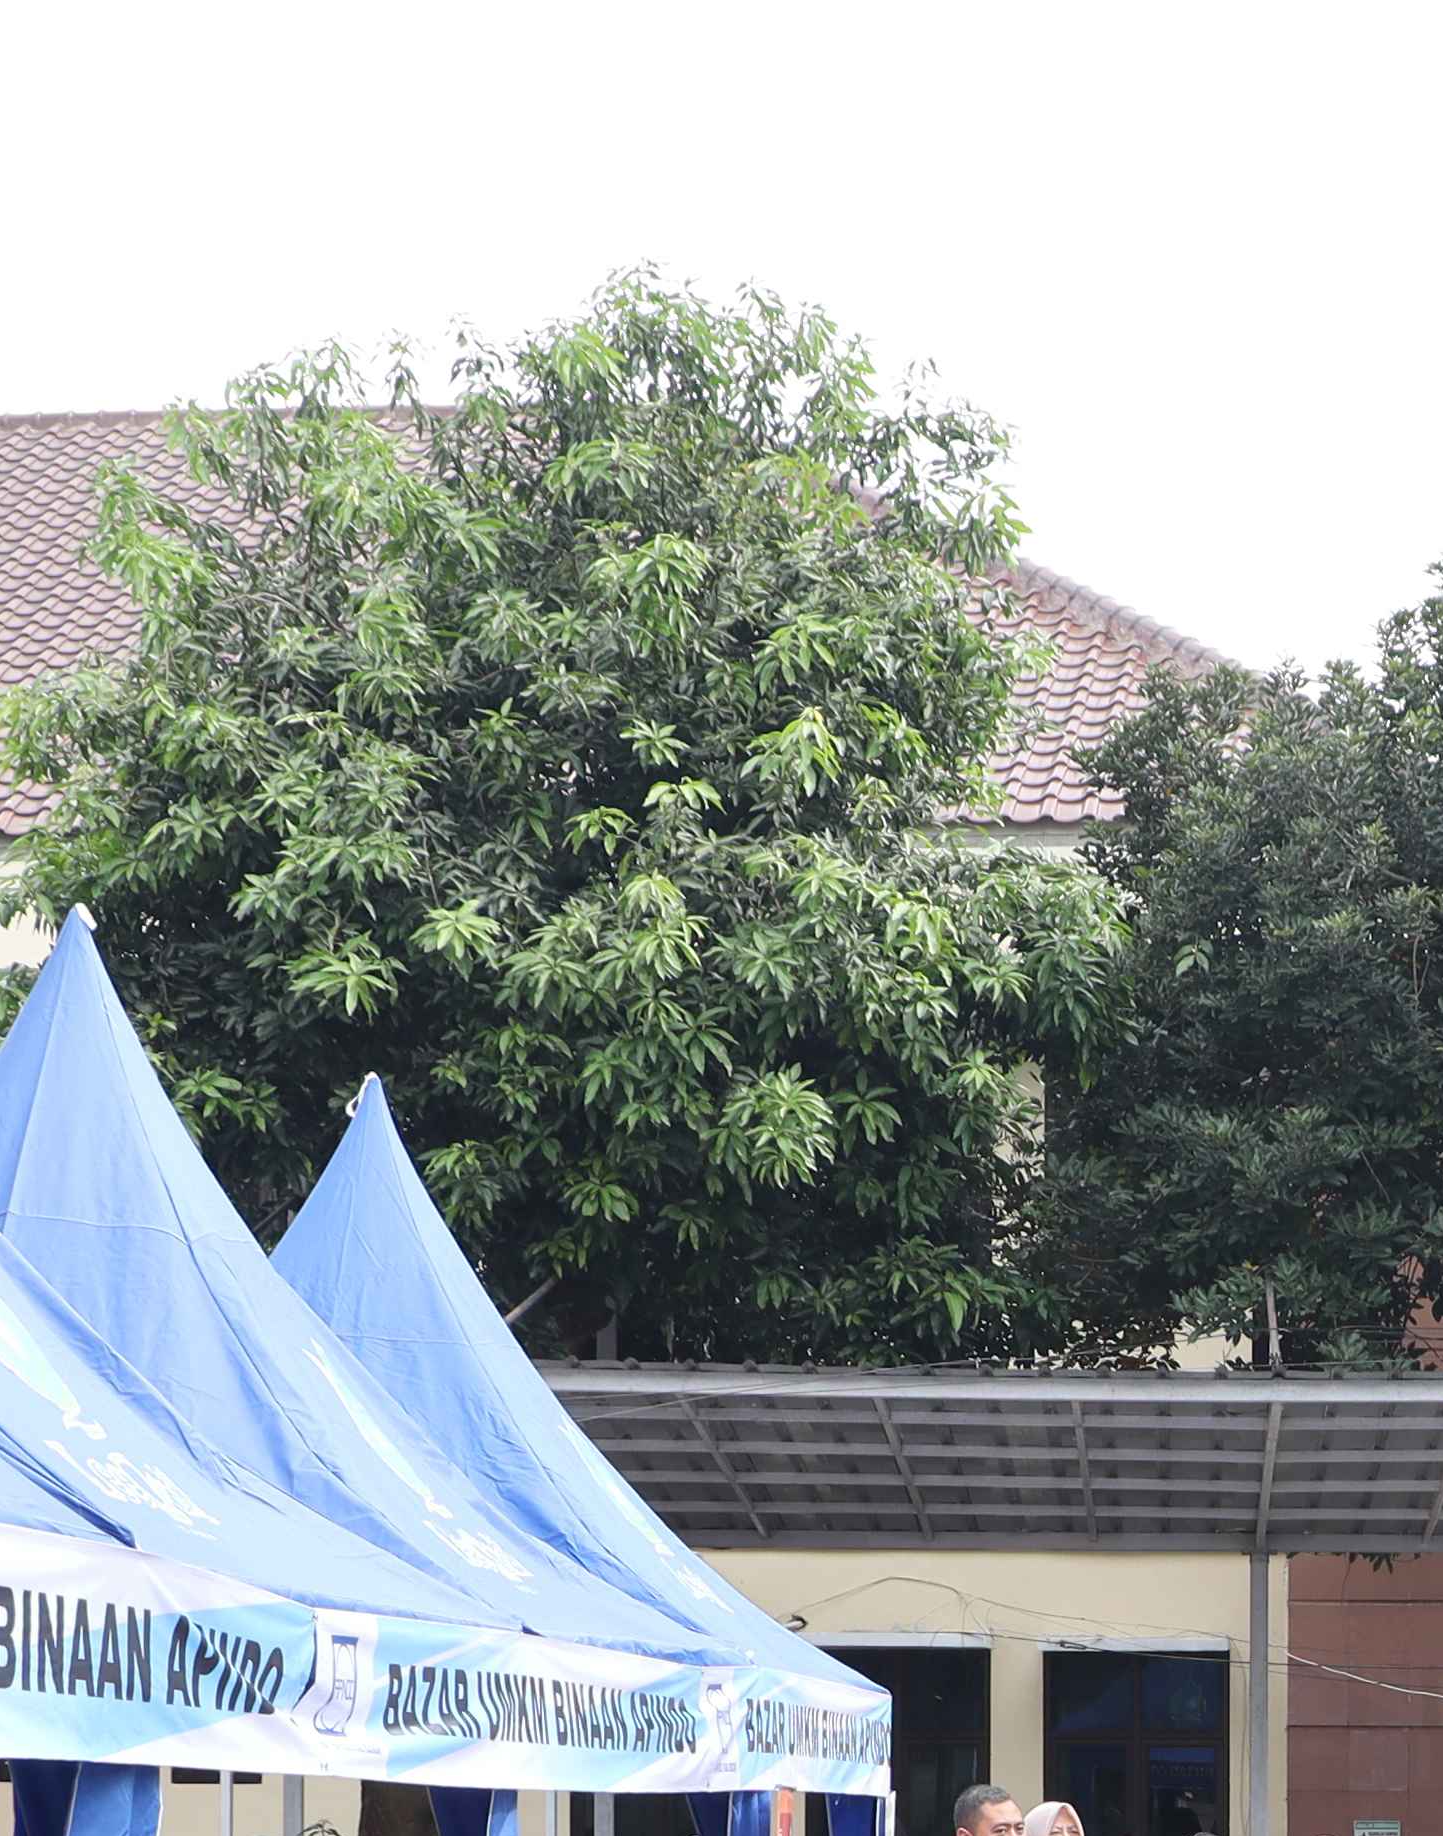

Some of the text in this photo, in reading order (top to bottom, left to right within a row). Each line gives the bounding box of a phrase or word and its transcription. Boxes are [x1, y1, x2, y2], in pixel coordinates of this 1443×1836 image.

[166, 1614, 284, 1715] APINDO
[383, 1664, 697, 1754] BAZAR UMKM BINAAN APINDO
[745, 1698, 786, 1755] BAZAR
